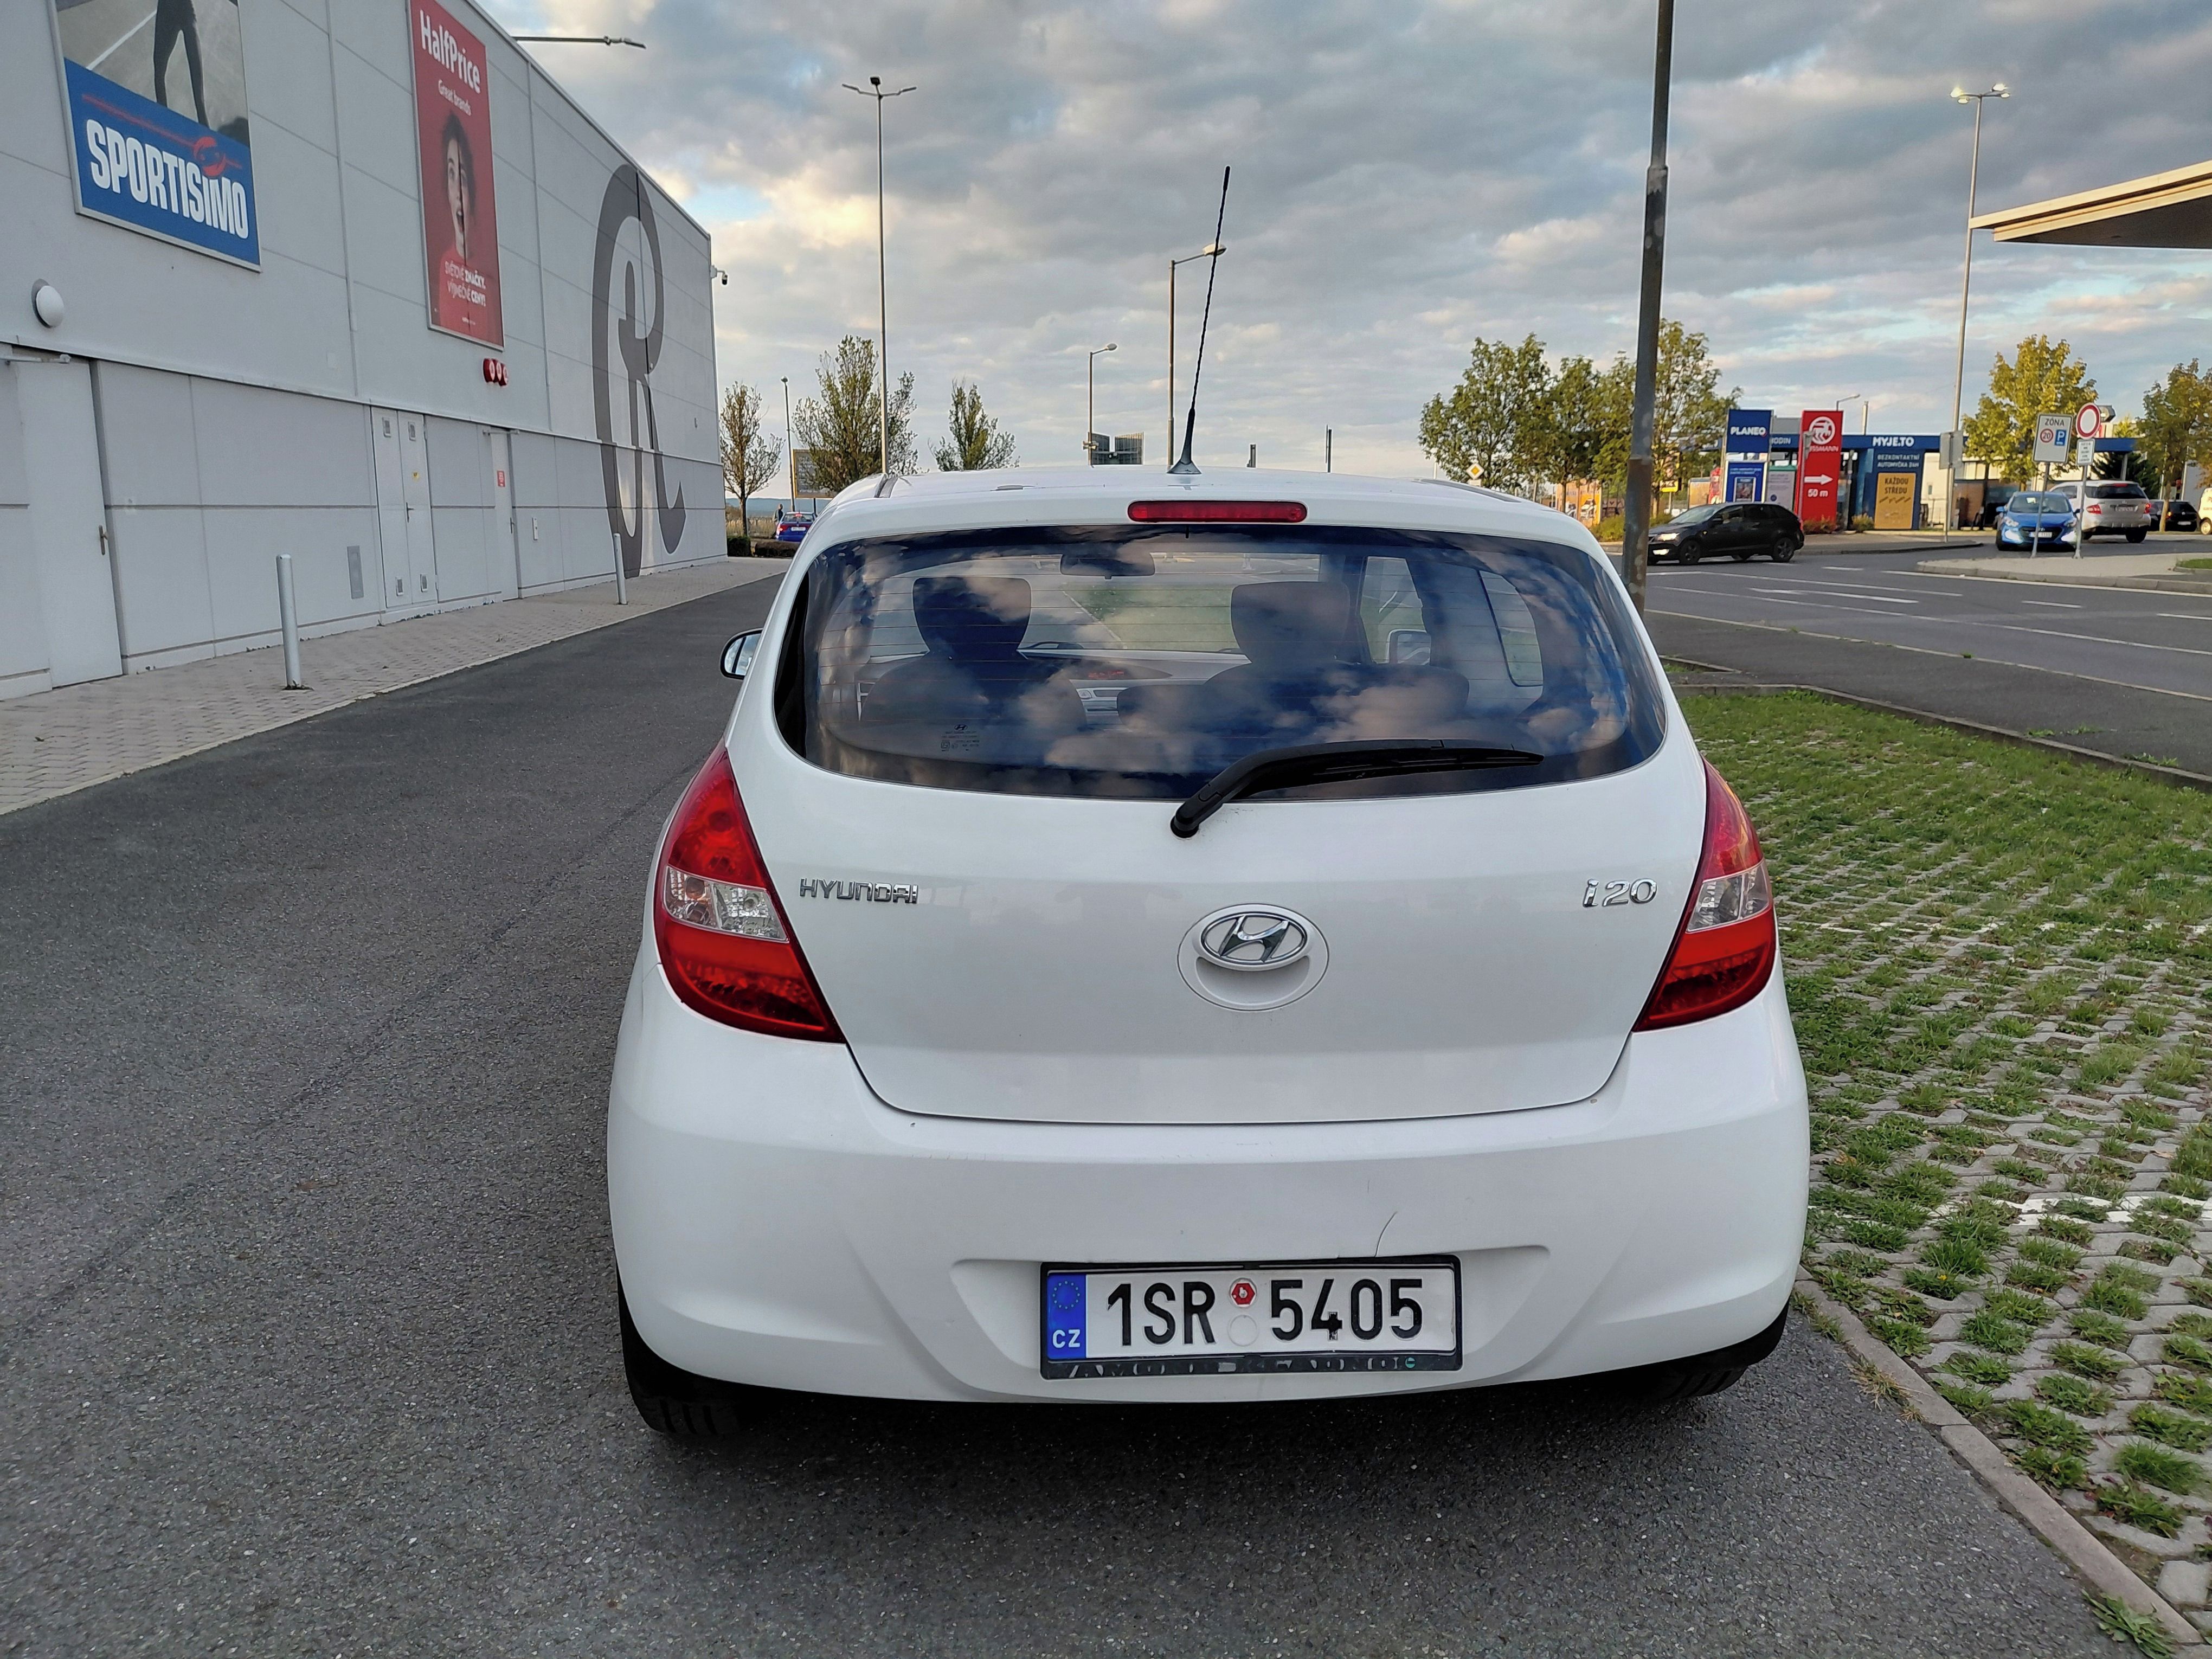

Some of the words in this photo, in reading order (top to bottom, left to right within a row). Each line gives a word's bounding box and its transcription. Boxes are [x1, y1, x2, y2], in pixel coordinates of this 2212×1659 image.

[420, 9, 481, 94] HalfPrice
[86, 119, 249, 239] SPORTISIMO
[1730, 427, 1767, 436] PLANEO
[1872, 436, 1915, 447] MYJE.TO
[1807, 488, 1818, 498] 50
[799, 877, 918, 904] HYUNDAI
[1052, 1328, 1081, 1349] CZ
[1108, 1280, 1217, 1347] 1SR
[1270, 1278, 1424, 1343] 5405
